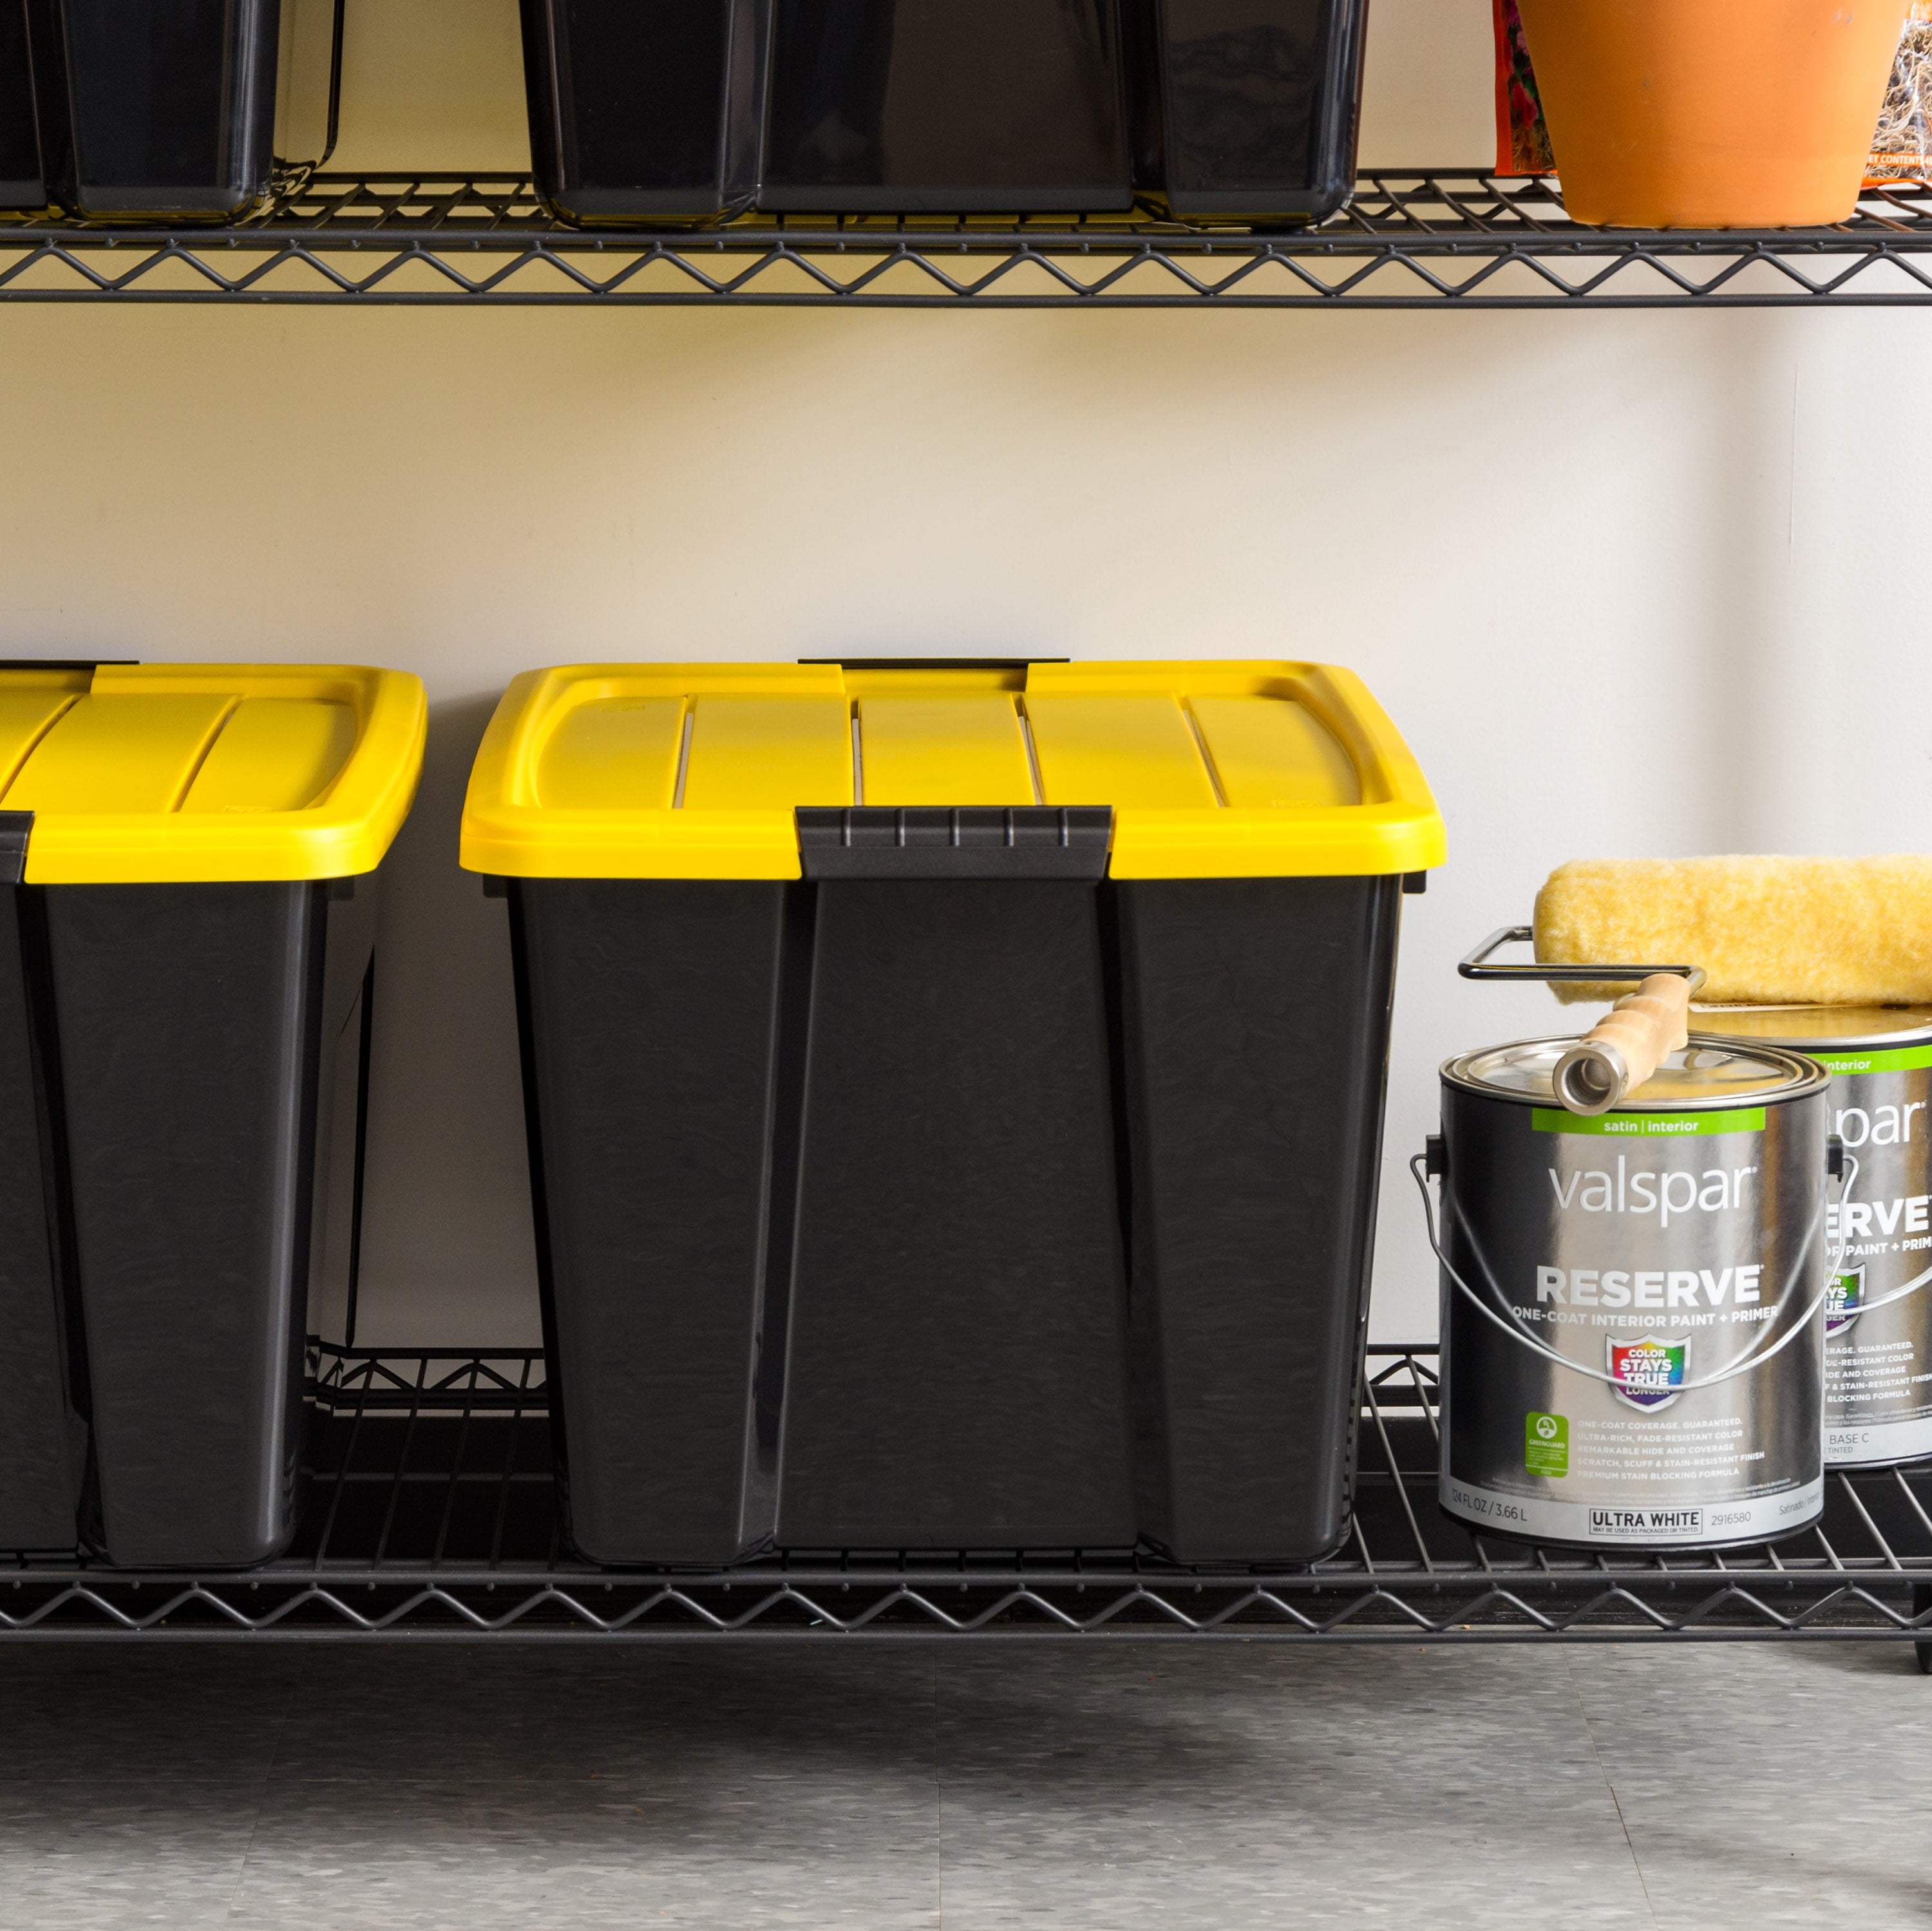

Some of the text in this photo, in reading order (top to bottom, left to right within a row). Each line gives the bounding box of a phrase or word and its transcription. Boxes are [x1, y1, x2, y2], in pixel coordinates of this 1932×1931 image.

[1604, 1121, 1638, 1132] satin
[1647, 1120, 1699, 1132] interior
[1828, 1101, 1920, 1148] par
[1548, 1154, 1752, 1228] valspar
[1846, 1242, 1888, 1256] PAINT
[1537, 1264, 1760, 1308] RESERVE
[1513, 1305, 1779, 1328] ONE-COAT INTERIOR PAINT + PRIMER
[1628, 1349, 1666, 1358] COLOR
[1858, 1341, 1913, 1353] GUARANTEED.
[1620, 1358, 1672, 1372] STAYS
[1888, 1353, 1914, 1363] COLOR
[1624, 1373, 1669, 1385] TRUE
[1842, 1370, 1861, 1379] AND
[1862, 1366, 1906, 1377] COVERAGE
[1840, 1377, 1909, 1391] STAIN-RESISTANT
[1827, 1389, 1911, 1403] BLOCKING FORMULA
[1578, 1417, 1743, 1430] ONE-COAT COVERAGE. GUARANTEED.
[1577, 1429, 1743, 1444] ULTRA-RICH, FADE-RESISTANT COLOR
[1830, 1433, 1869, 1445] BASE C
[1577, 1443, 1734, 1455] REMARKABLE HIDE AND COVERAGE
[1577, 1457, 1622, 1468] SCRATCH,
[1664, 1455, 1739, 1467] STAIN-RESISTANT
[1740, 1451, 1765, 1462] FINISH
[1577, 1467, 1739, 1480] PREMIUM STAIN BLOCKING FORMULA
[1463, 1493, 1472, 1509] FL
[1473, 1498, 1487, 1513] OZ
[1488, 1501, 1494, 1516] /
[1495, 1503, 1518, 1520] 3.66
[1521, 1508, 1527, 1521] L
[1779, 1499, 1804, 1515] Satinado
[1593, 1512, 1699, 1527] ULTRA WHITE
[1711, 1511, 1752, 1526] 2916580
